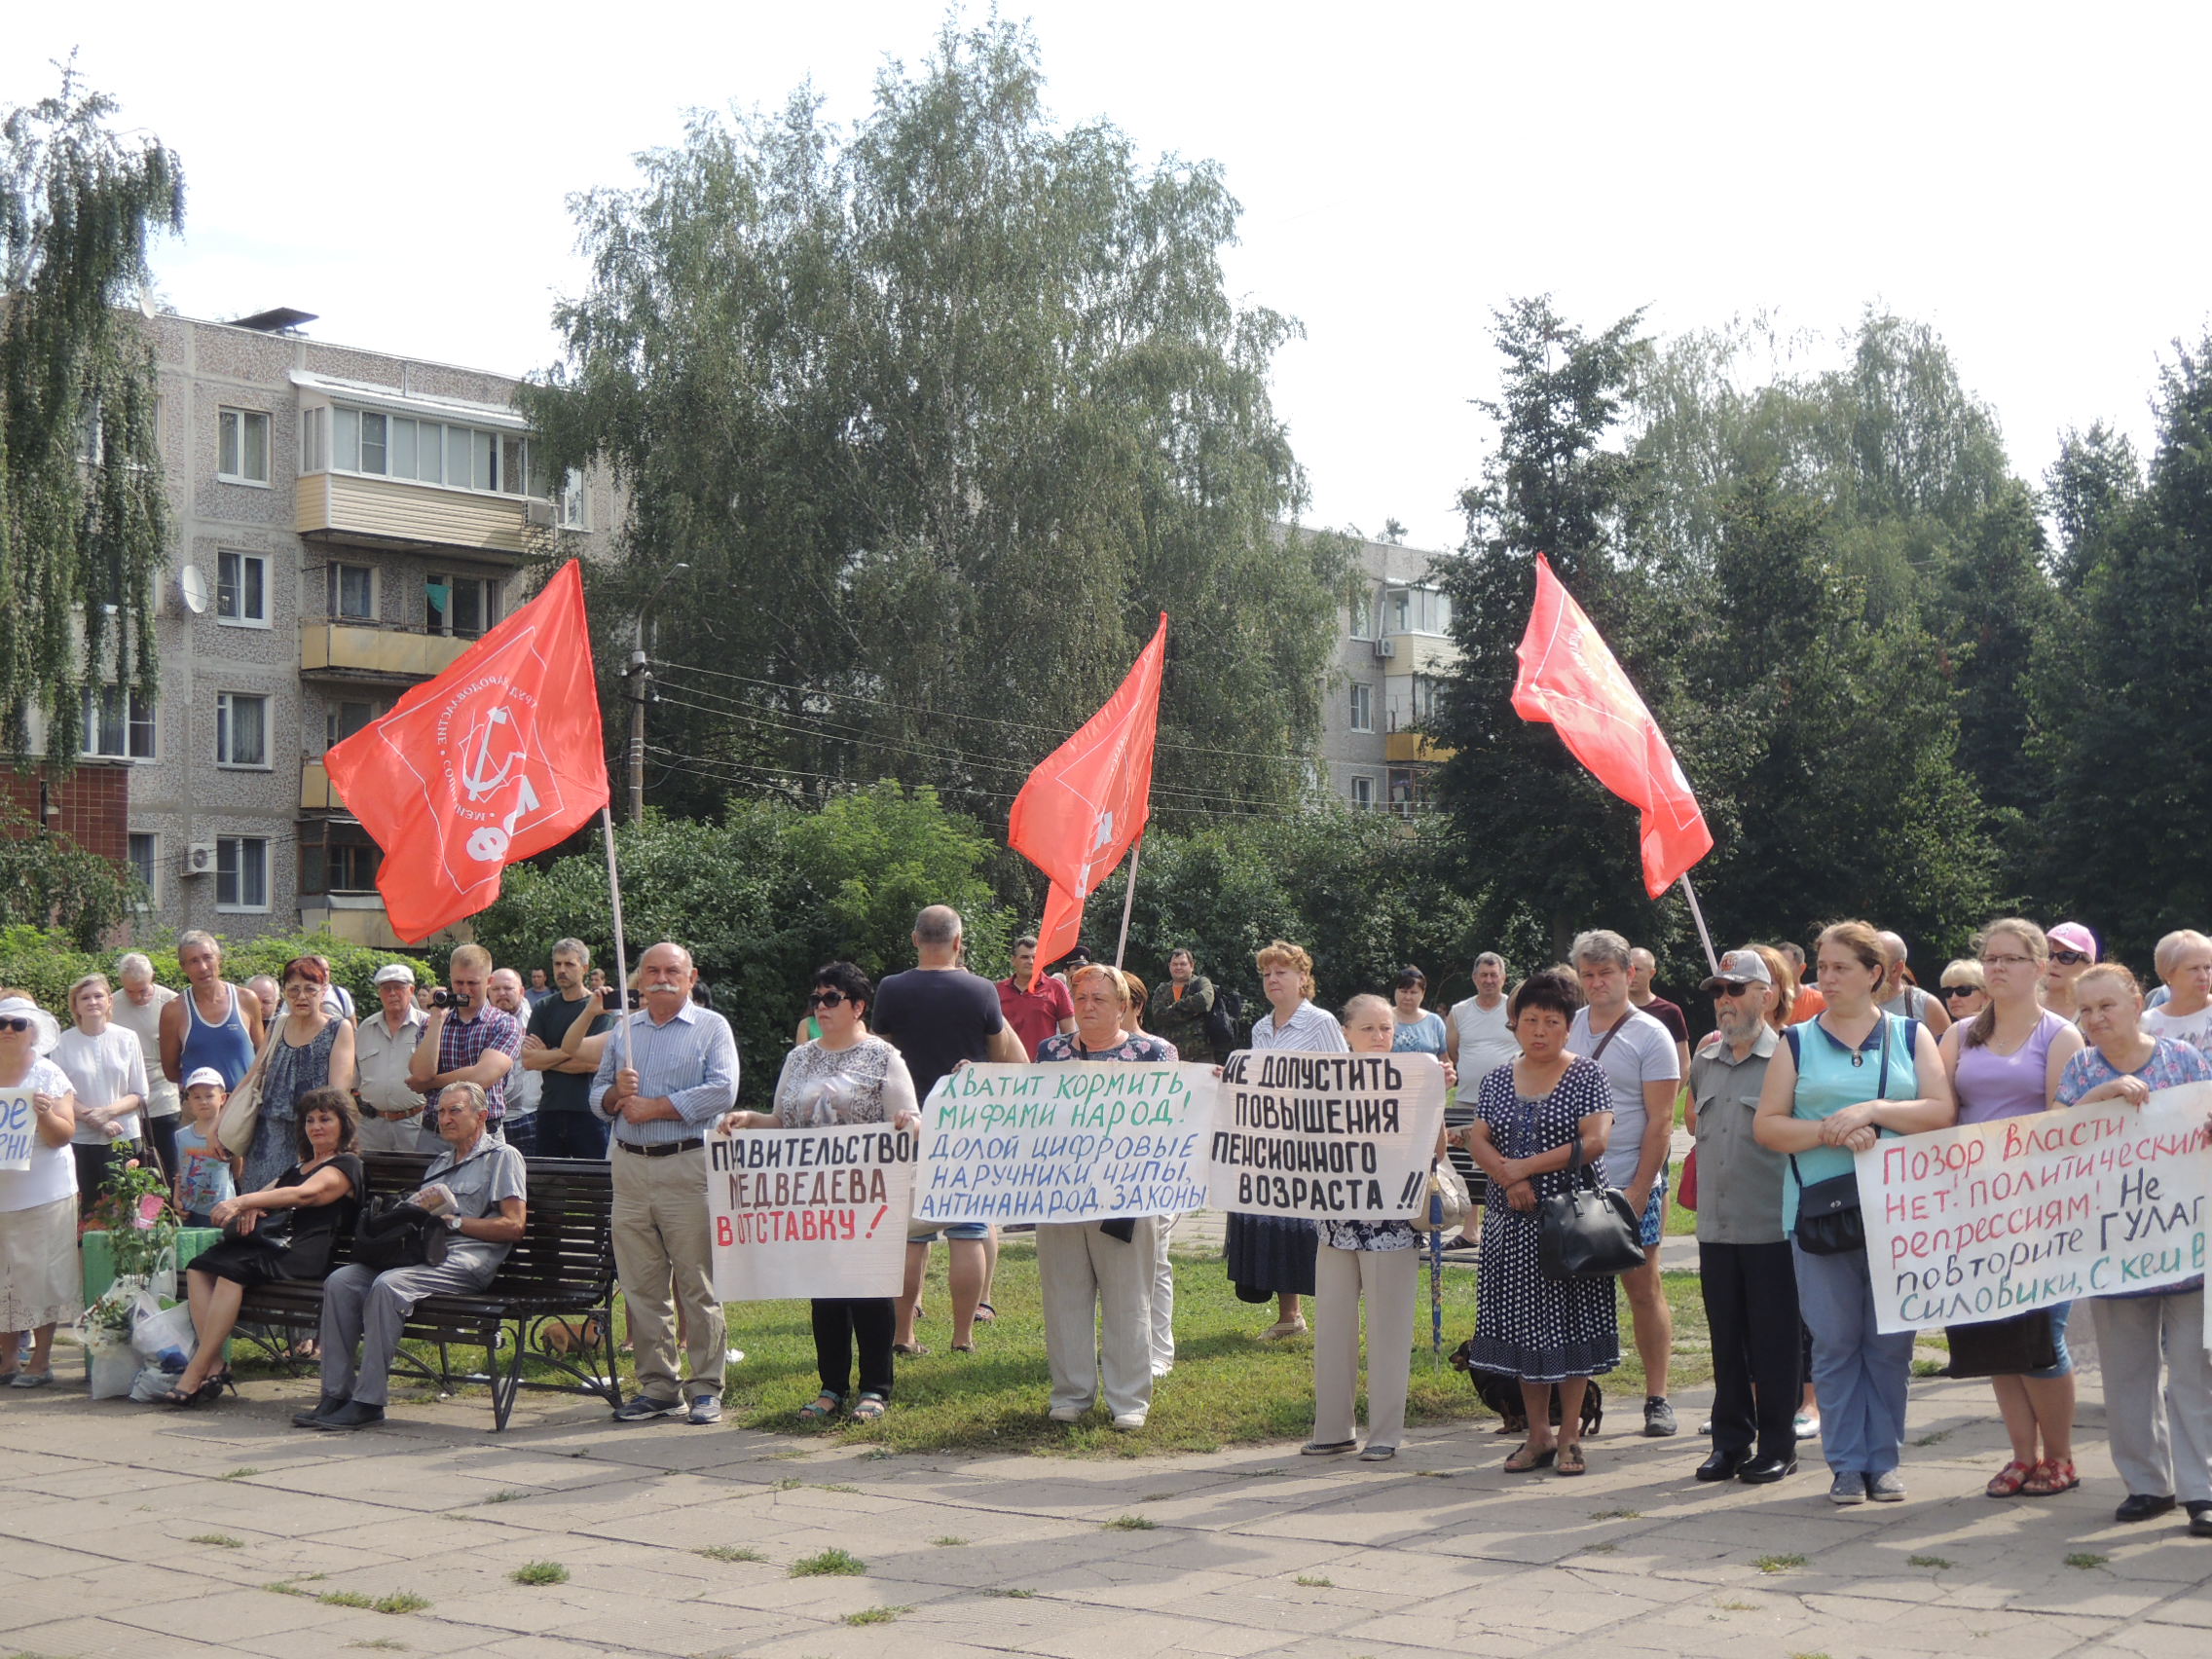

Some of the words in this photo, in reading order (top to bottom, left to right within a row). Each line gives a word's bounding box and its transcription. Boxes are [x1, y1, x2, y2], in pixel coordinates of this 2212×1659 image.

[940, 1067, 1045, 1099] ХВАТИТ
[1222, 1054, 1251, 1085] НЕ
[1258, 1055, 1402, 1091] ДОПУСТИТЬ
[935, 1102, 1057, 1133] МИФАМИ
[1070, 1089, 1192, 1138] НАРОД!
[1235, 1092, 1400, 1135] ПОВЫШЕНИЯ
[928, 1133, 1019, 1161] ДОЛОЙ
[1031, 1132, 1199, 1164] ЦИФРОВЫЕ
[1211, 1131, 1378, 1175] ПЕНСИОННОГО
[729, 1168, 887, 1211] МЕДВЕДЕВА
[1103, 1161, 1192, 1186] ЧИПЫ,
[2120, 1166, 2163, 1208] Не
[1110, 1184, 1207, 1212] ЗАКОНЫ
[1897, 1228, 2083, 1296] повторите
[2099, 1196, 2205, 1252] ГУЛАГ
